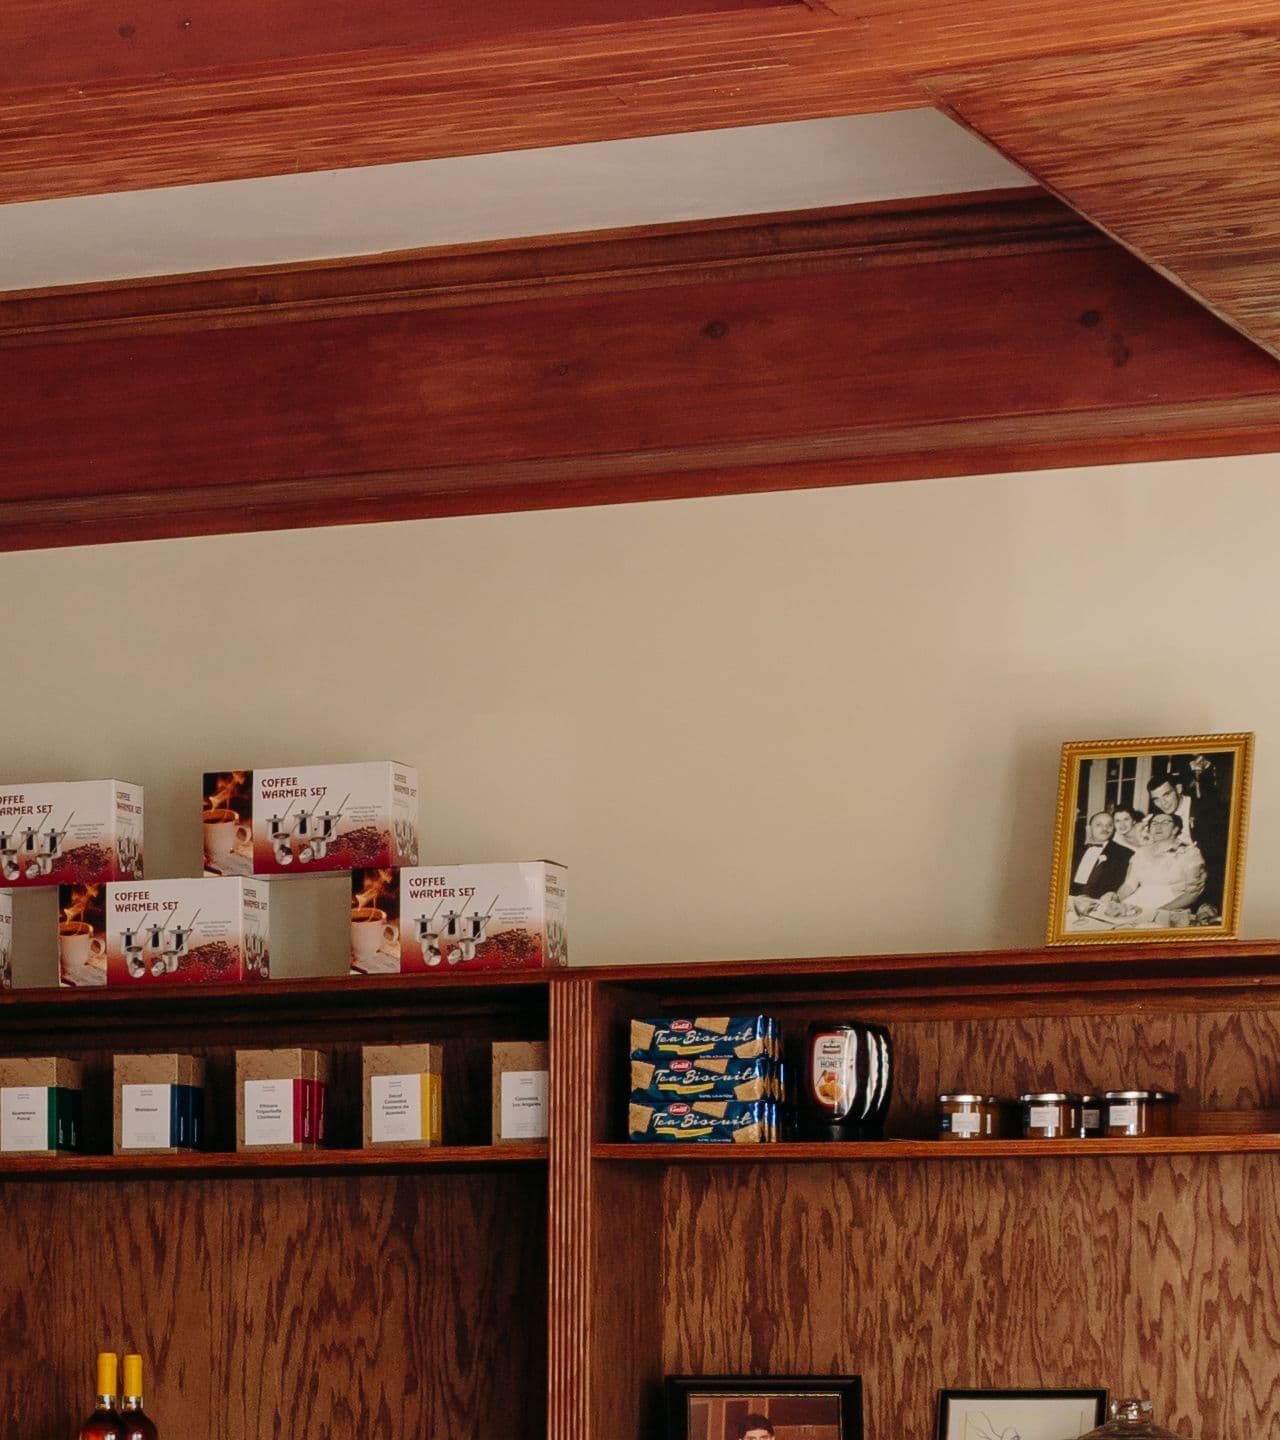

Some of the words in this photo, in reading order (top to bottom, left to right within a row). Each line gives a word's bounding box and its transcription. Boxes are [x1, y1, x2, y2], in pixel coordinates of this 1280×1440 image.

[261, 777, 298, 788] COFFEE
[261, 788, 307, 799] WARMER
[310, 787, 327, 796] SET
[36, 805, 53, 814] SET
[409, 877, 446, 887] COFFEE
[115, 891, 149, 901] COFFEE
[409, 888, 456, 899] WARMER
[459, 887, 476, 896] SET
[115, 902, 159, 912] WARMER
[162, 901, 179, 910] SET
[654, 1030, 682, 1044] Tea
[654, 1070, 682, 1084] Tea
[653, 1113, 680, 1127] Tea
